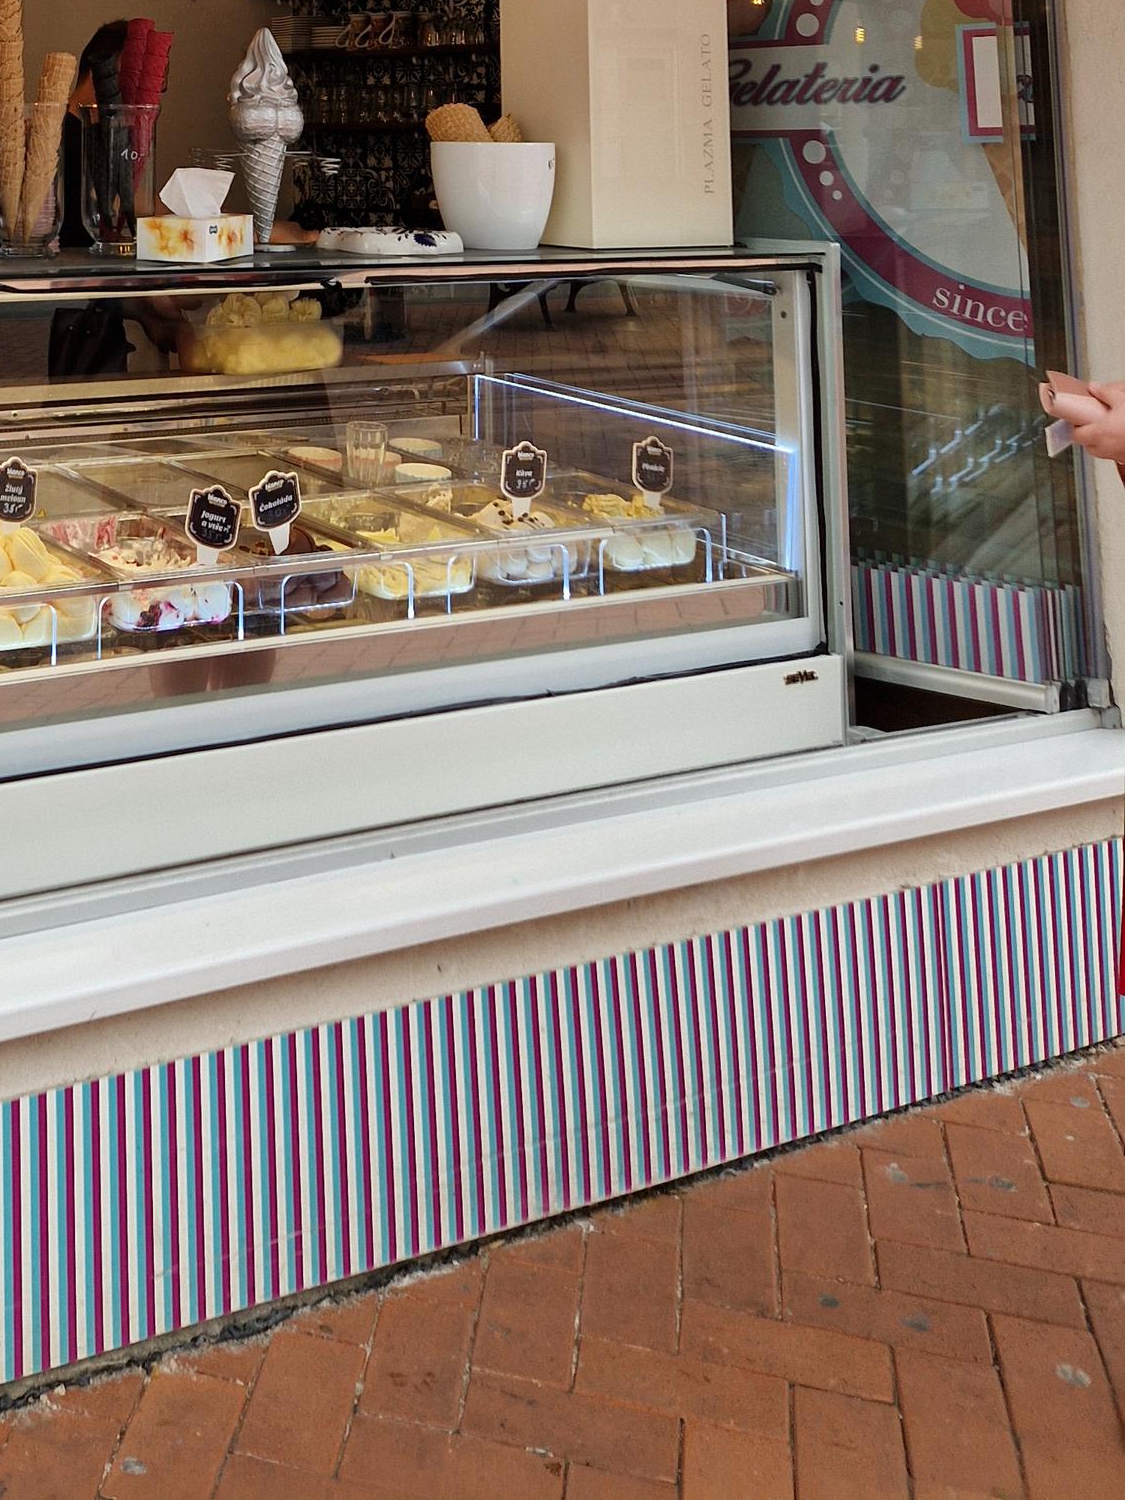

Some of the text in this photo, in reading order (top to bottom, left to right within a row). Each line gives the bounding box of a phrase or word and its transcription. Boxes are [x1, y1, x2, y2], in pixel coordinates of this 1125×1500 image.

[700, 33, 715, 194] PLAZMA GELATO
[932, 284, 1028, 332] since
[201, 510, 227, 524] Jogurt
